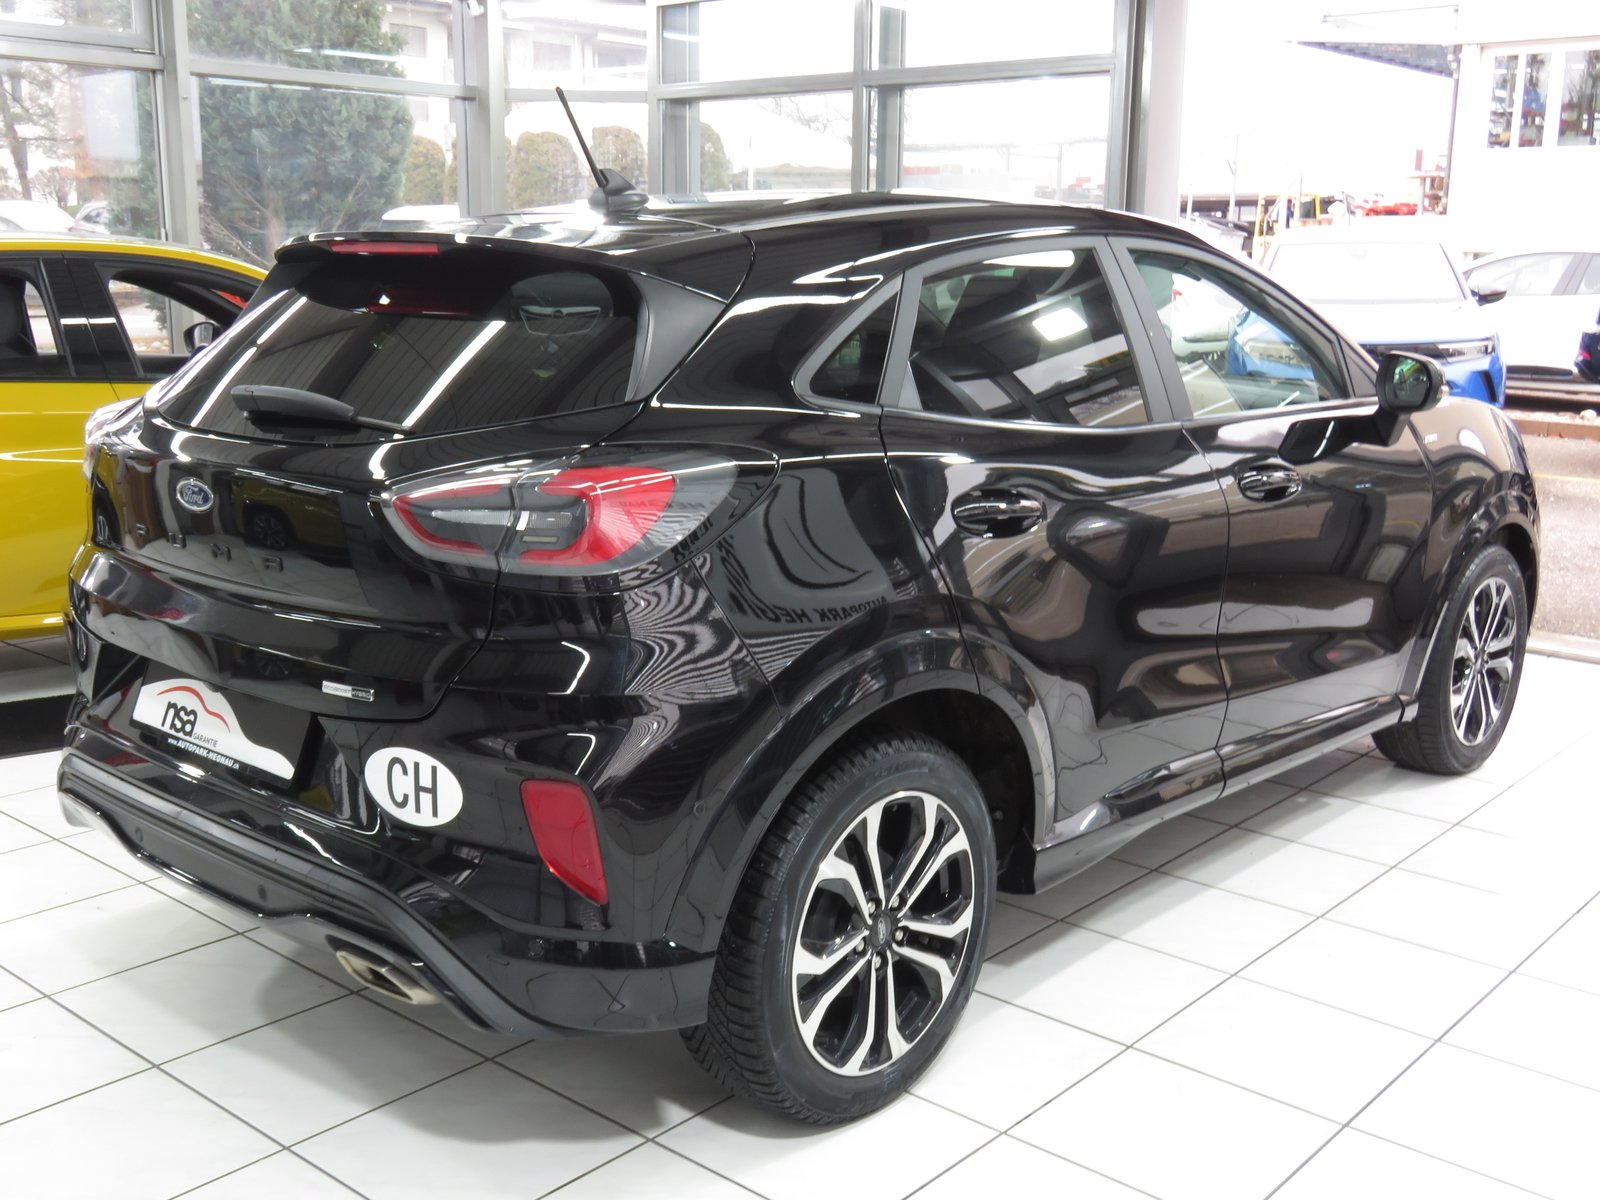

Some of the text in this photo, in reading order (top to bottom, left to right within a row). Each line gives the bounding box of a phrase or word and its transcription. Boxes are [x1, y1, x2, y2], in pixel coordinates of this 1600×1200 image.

[179, 482, 209, 507] Ford
[161, 701, 198, 738] nsa
[193, 732, 219, 748] GARANTIE
[387, 756, 438, 818] CH
